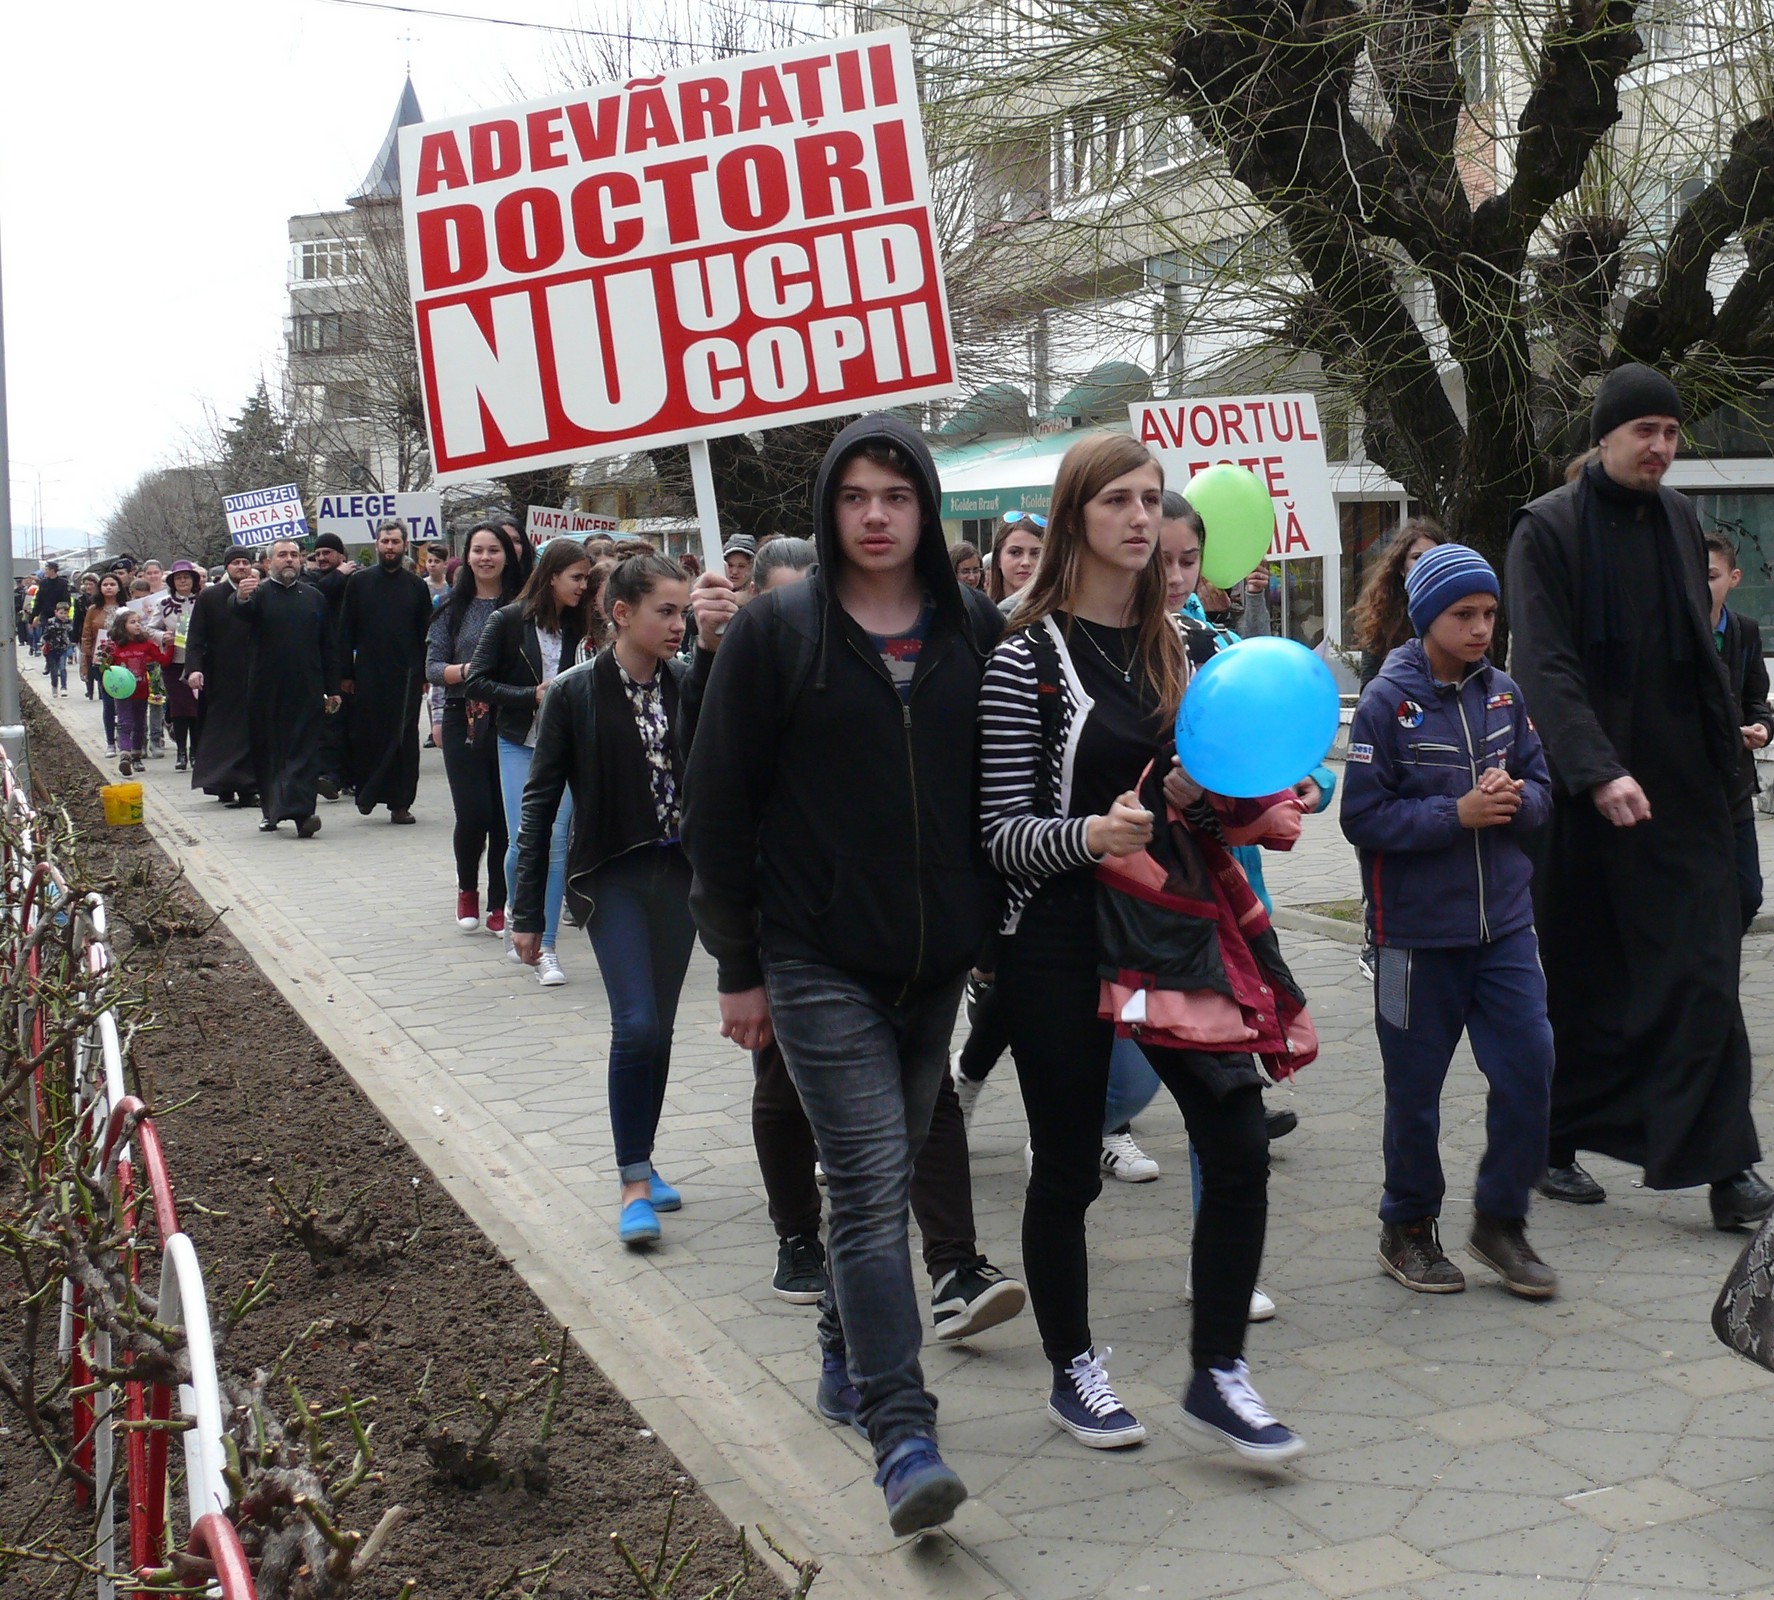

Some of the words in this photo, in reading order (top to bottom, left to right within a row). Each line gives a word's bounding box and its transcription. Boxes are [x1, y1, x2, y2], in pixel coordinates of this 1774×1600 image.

[416, 118, 915, 293] DOCTORI
[427, 268, 668, 459] NU
[671, 223, 925, 333] UCID
[682, 302, 937, 415] COPII
[1139, 401, 1318, 449] AVORTUL
[1188, 456, 1290, 498] TE
[224, 486, 298, 512] DUMNEZEU
[319, 494, 396, 519] ALEGE
[954, 497, 977, 512] Golden
[366, 516, 438, 541] VȚA
[532, 511, 568, 534] VIAȚA
